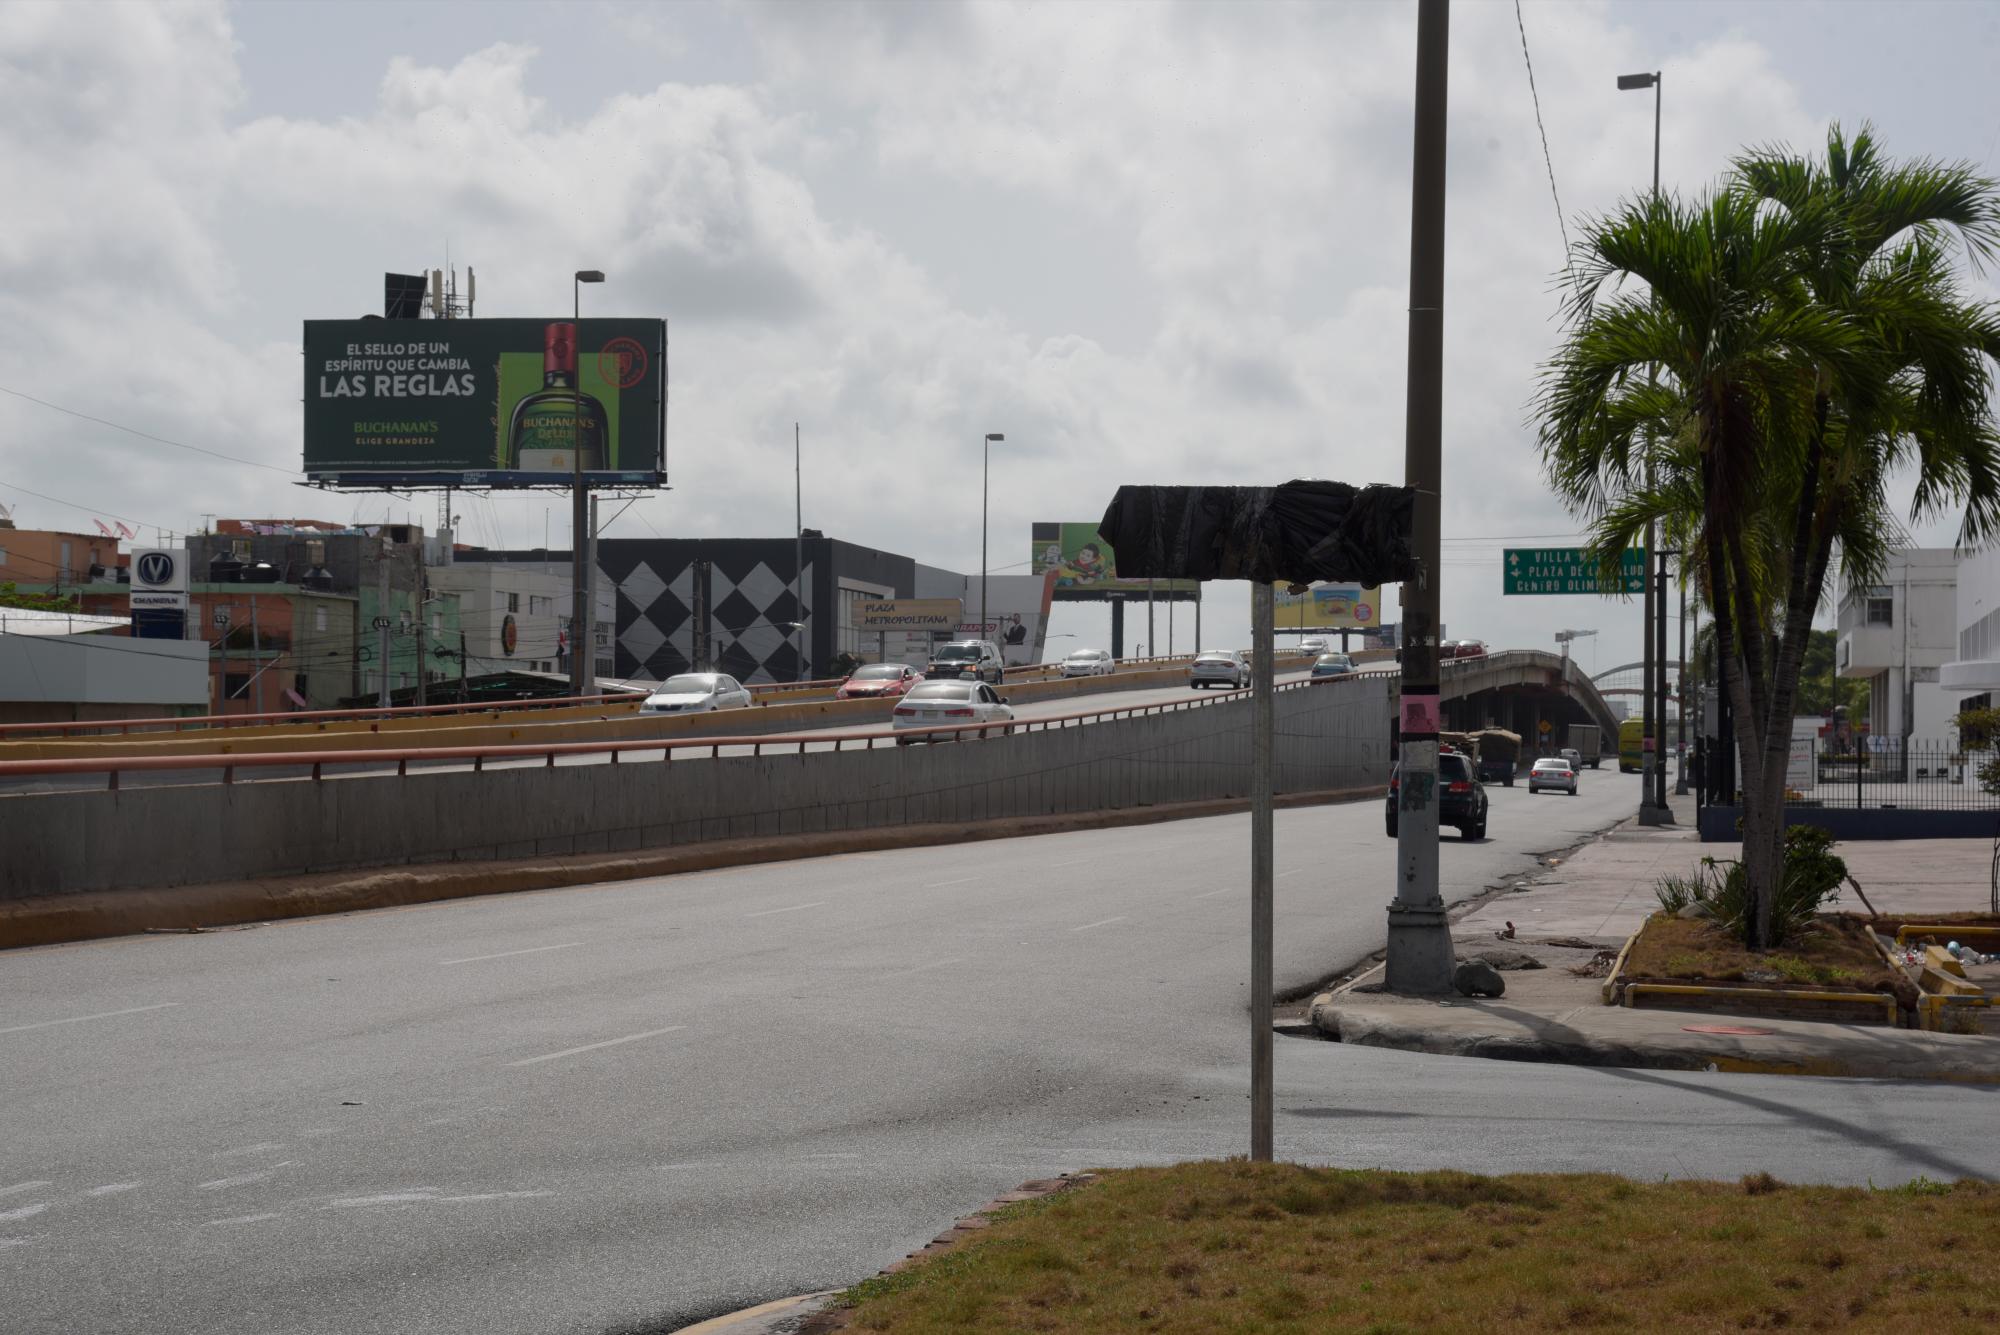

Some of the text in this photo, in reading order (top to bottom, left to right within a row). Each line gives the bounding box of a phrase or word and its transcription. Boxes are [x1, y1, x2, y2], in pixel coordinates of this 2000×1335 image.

[347, 342, 449, 355] EL SELLO DE UN
[325, 357, 471, 373] ESPÍRITU QUE CAMBIA
[320, 374, 475, 398] LAS REGLAS
[354, 420, 439, 433] BUCHANAN'S
[356, 437, 435, 445] ELIGE GRANDEZA
[1535, 551, 1571, 563] VILLA
[1528, 566, 1564, 577] PLAZA
[1570, 565, 1583, 577] DE
[1517, 580, 1560, 592] CENTRO
[865, 604, 896, 613] PLAZA
[864, 616, 948, 625] METROPOLITANA
